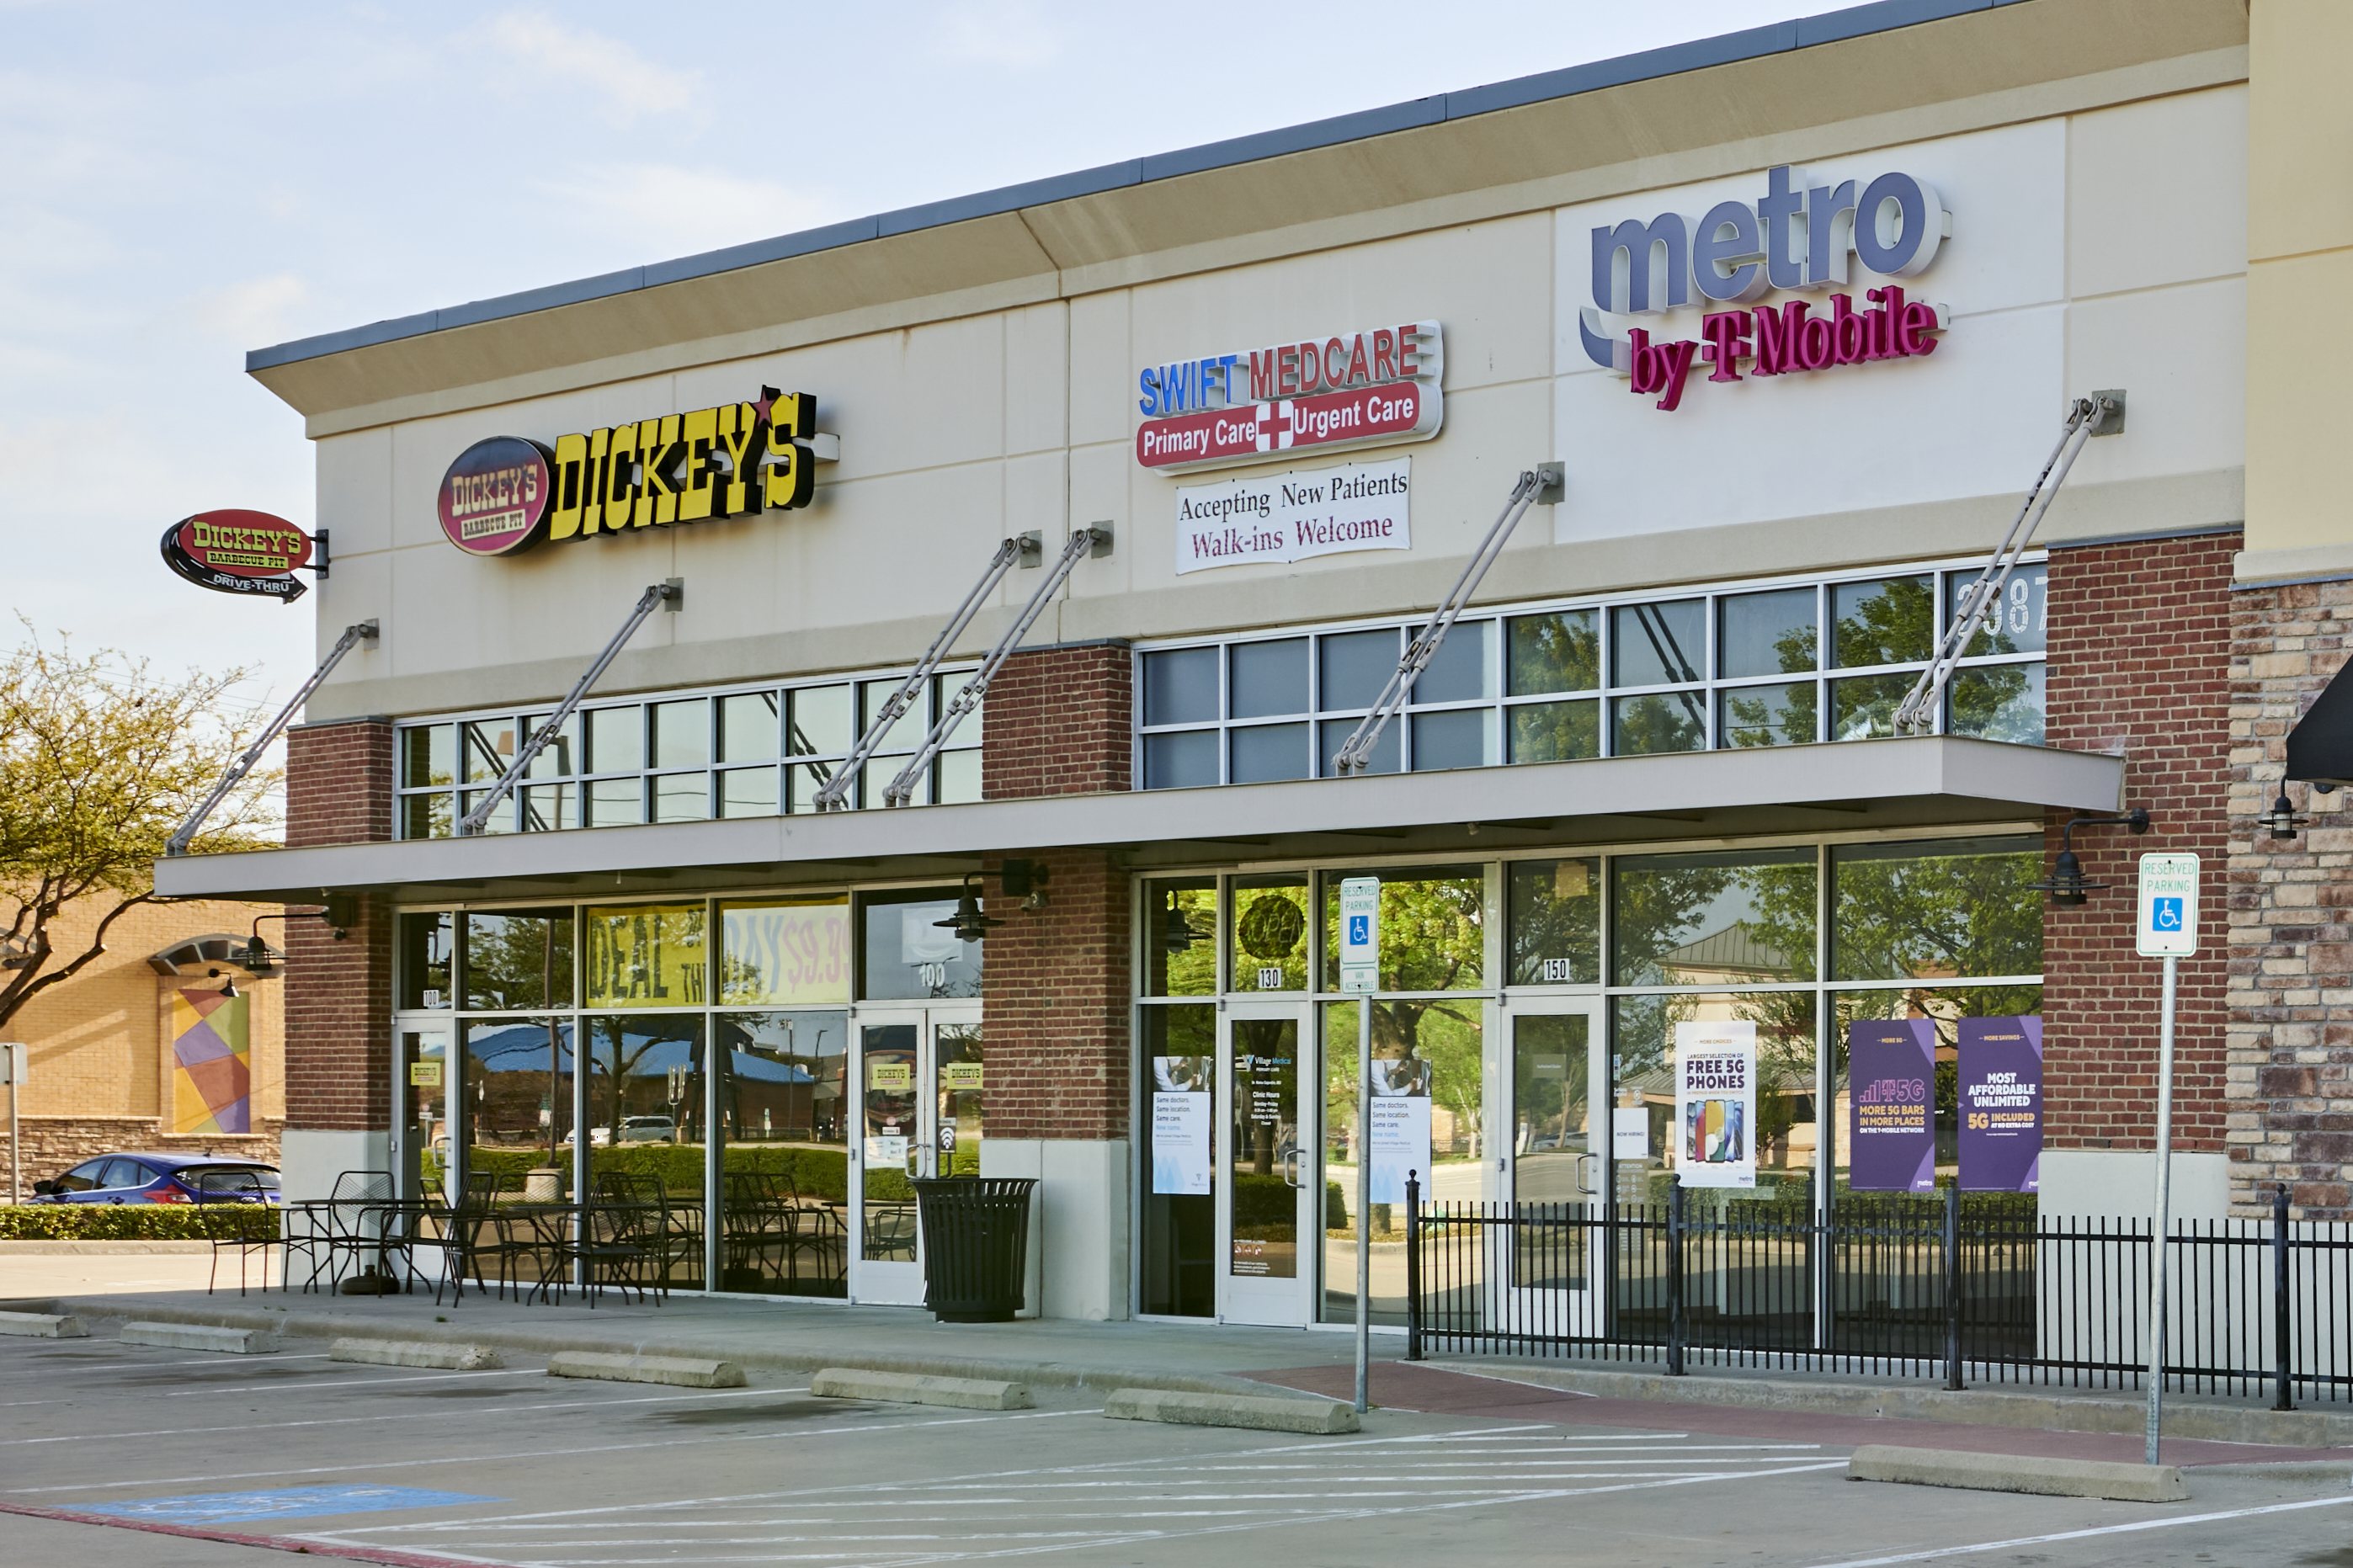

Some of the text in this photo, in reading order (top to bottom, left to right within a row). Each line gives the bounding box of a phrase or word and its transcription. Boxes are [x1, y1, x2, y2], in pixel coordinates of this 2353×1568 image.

[1592, 165, 1927, 314] metro
[1139, 324, 1419, 417] SWIFT MEDCARE
[1627, 328, 1699, 412] by
[1143, 396, 1414, 456] Primary Care Urgent Care
[550, 392, 801, 541] DICKEY'S
[451, 464, 538, 518] DICKEY'S
[1179, 472, 1408, 523] Accepting New Patients
[463, 512, 524, 537] BARBECUE PIT
[193, 521, 301, 555] DICKEY'S
[1192, 516, 1393, 559] Walk-ins Welcome
[210, 552, 286, 567] BARBECUE PIT
[213, 574, 290, 593] DRIVE-THRU
[2144, 862, 2195, 875] RESERVED
[1344, 885, 1376, 897] RESERVED
[2147, 880, 2191, 892] PARKING
[1345, 901, 1374, 911] PARKING
[589, 915, 668, 999] DEAL
[722, 915, 784, 994] DAY
[918, 963, 945, 987] 100
[1546, 959, 1566, 979] 150
[1260, 970, 1278, 987] 130
[424, 991, 437, 1005] 100
[1255, 1057, 1271, 1066] Village
[1687, 1060, 1744, 1074] FREE 5G
[1687, 1075, 1744, 1089] PHONES
[1988, 1072, 2016, 1084] MOST
[1968, 1084, 2036, 1096] AFFORDABLE
[1860, 1105, 1886, 1115] MORE
[1887, 1105, 1899, 1115] 5G
[1902, 1105, 1925, 1115] BARS
[1973, 1096, 2031, 1107] UNLIMITED
[1860, 1117, 1925, 1126] IN MORE PLACES
[1968, 1113, 2035, 1129] 5G INCLUDED
